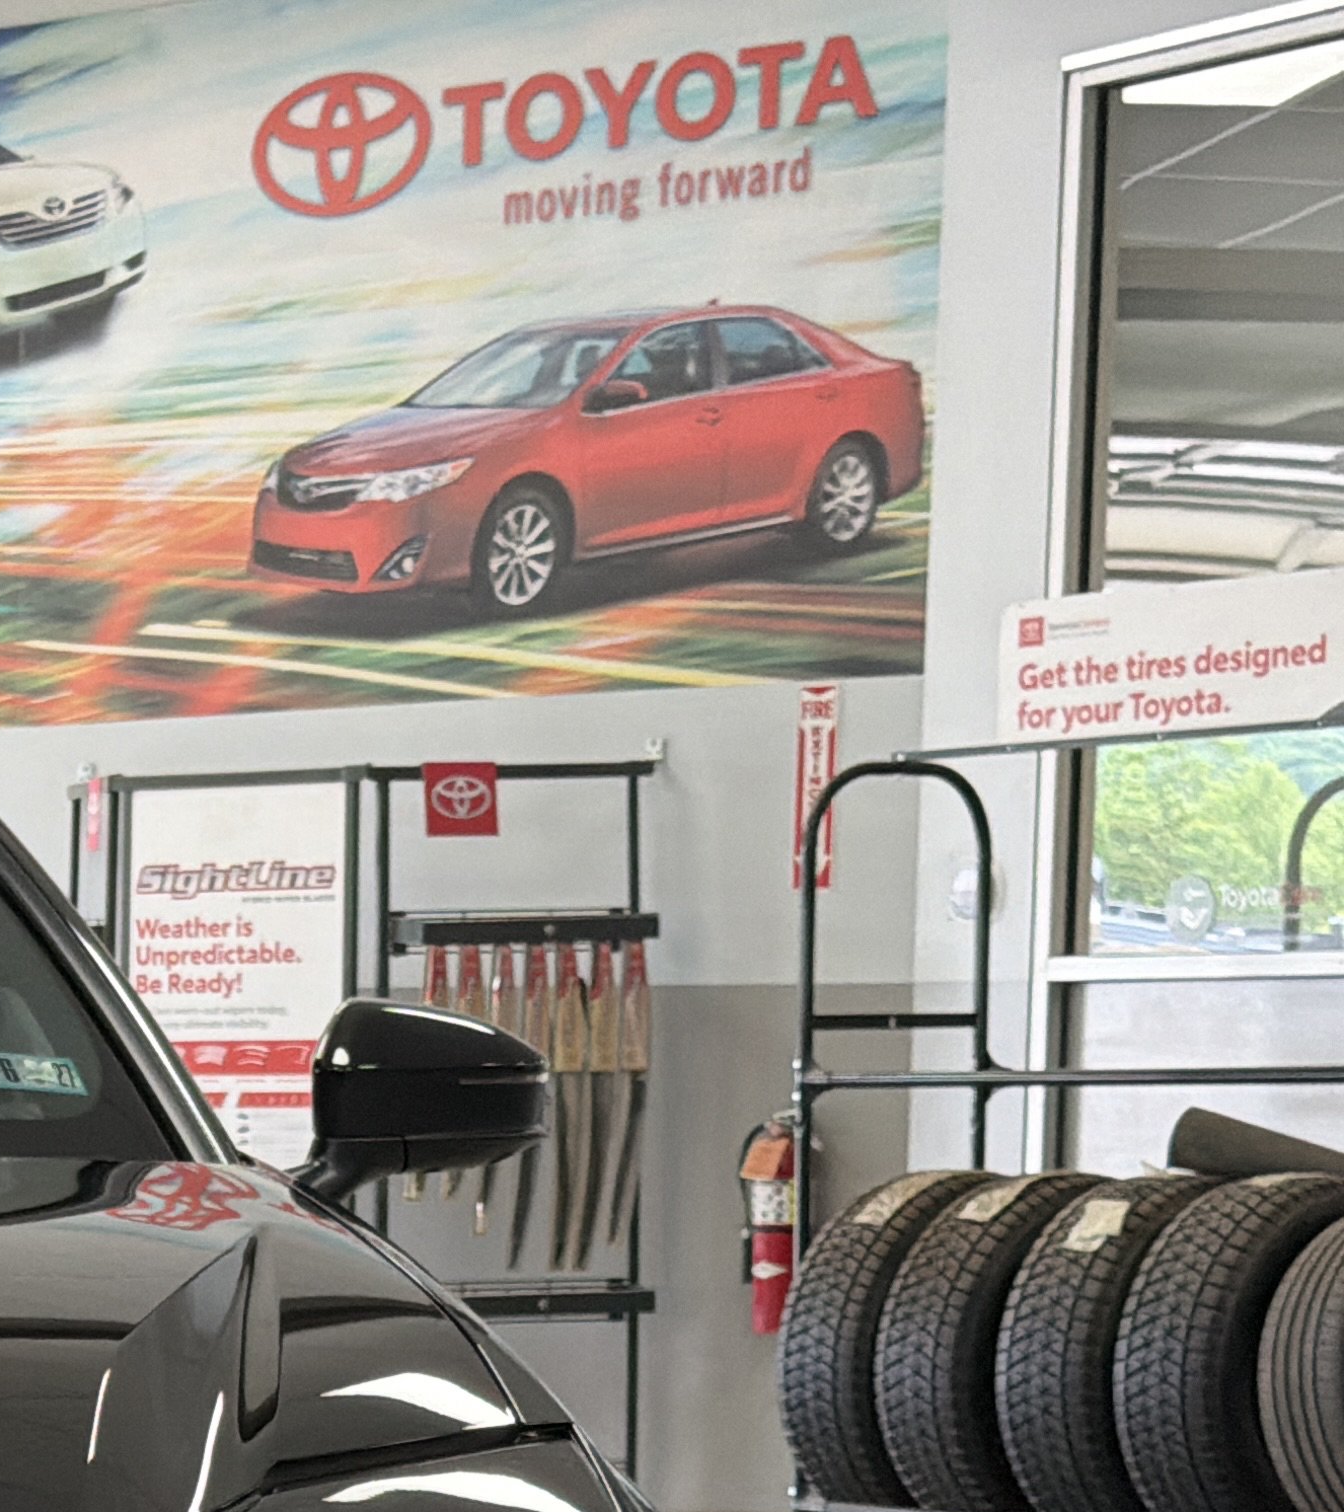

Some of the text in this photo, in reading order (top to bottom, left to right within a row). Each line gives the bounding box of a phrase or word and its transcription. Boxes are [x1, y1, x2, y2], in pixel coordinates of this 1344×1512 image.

[443, 35, 879, 167] TOYOTA
[504, 146, 812, 224] moving forward
[1018, 634, 1328, 690] Get the tires designed
[1019, 688, 1232, 734] for your Toyota.
[135, 861, 337, 900] SightLine
[135, 915, 253, 940] Weather is
[135, 942, 303, 970] Unpredictable.
[135, 972, 243, 998] Be Ready!
[51, 1062, 78, 1089] 27
